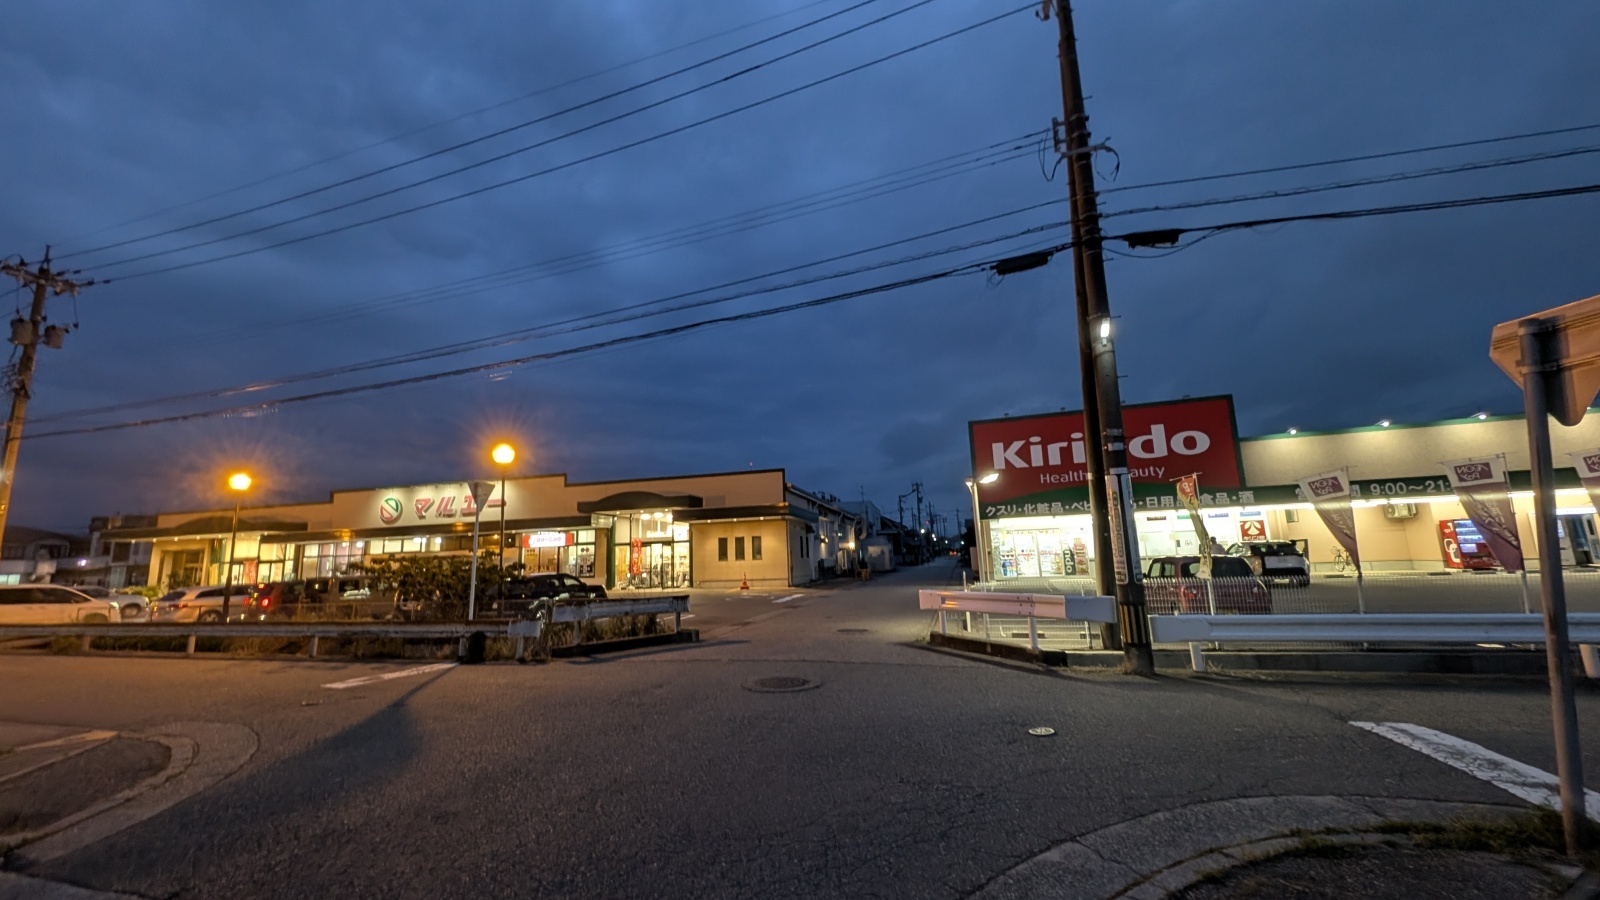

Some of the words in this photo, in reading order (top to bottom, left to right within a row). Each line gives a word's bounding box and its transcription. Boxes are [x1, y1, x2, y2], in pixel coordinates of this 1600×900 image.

[992, 424, 1210, 470] Kirido
[1040, 471, 1089, 484] Health
[1130, 466, 1165, 479] auty
